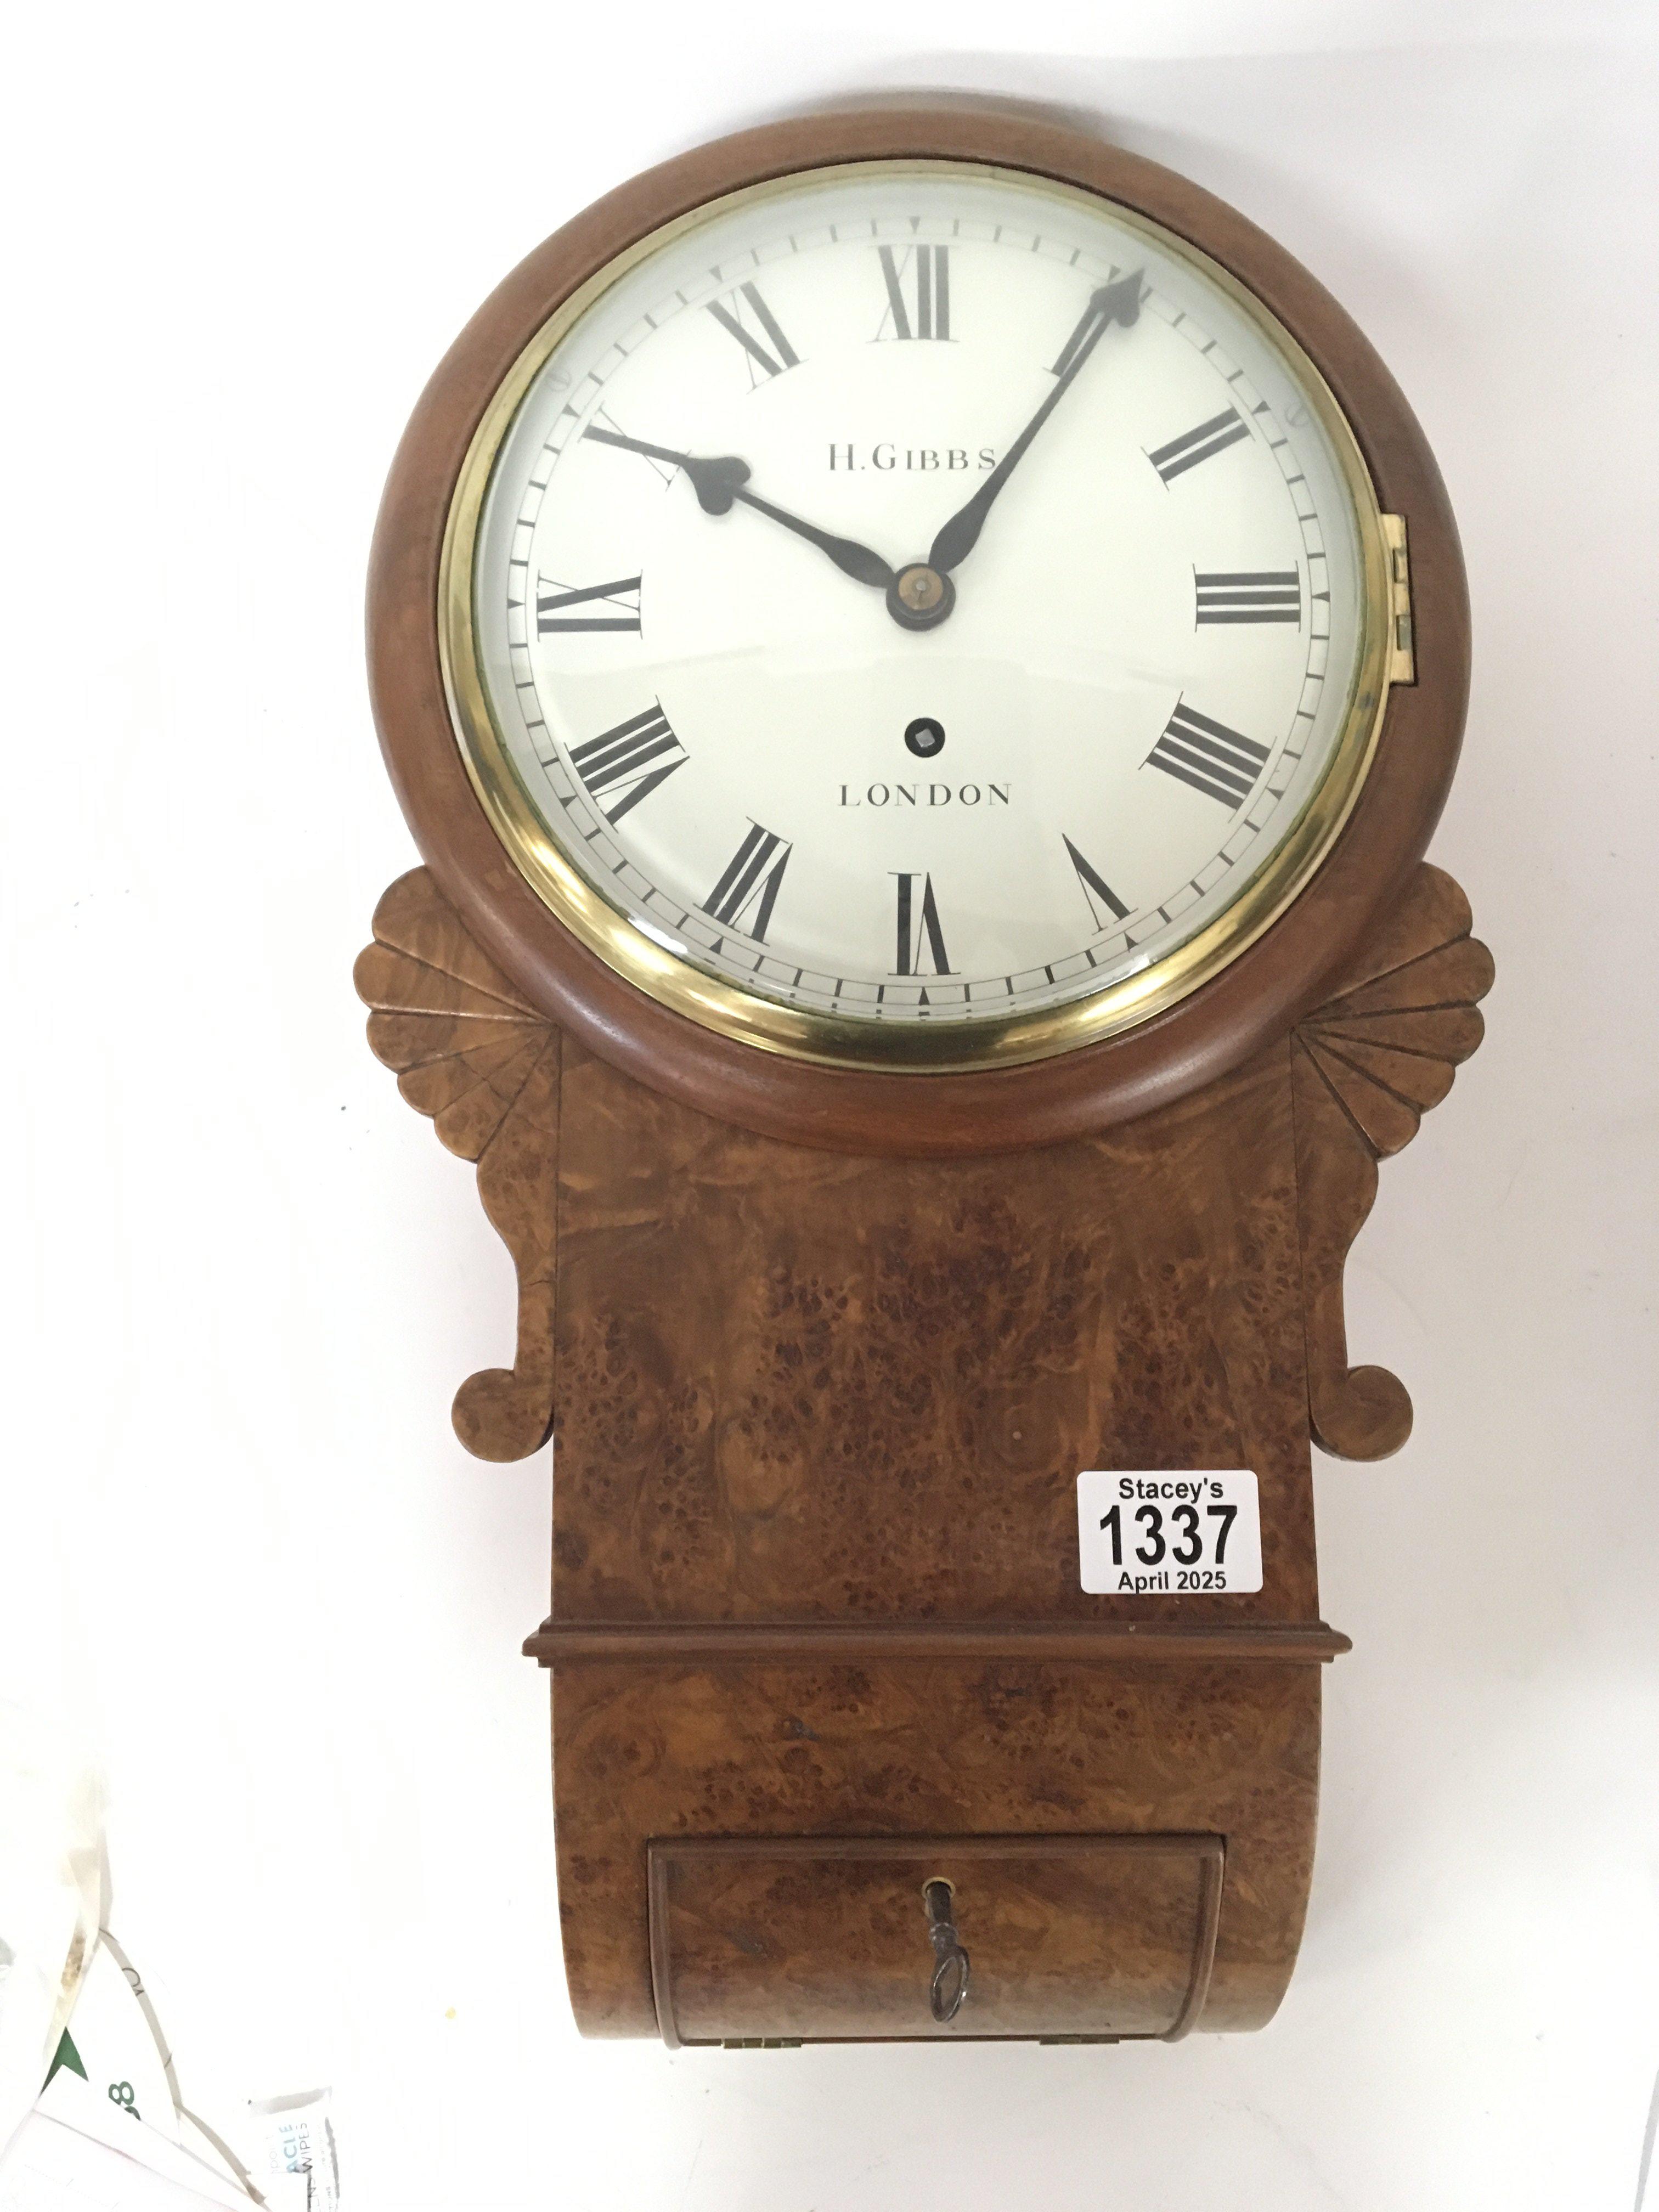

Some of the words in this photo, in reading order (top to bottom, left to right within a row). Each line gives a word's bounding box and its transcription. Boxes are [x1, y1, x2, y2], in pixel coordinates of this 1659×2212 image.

[705, 279, 810, 394] XI
[866, 243, 958, 343] XII
[1140, 401, 1256, 492] II
[537, 569, 643, 640] IX
[1193, 562, 1301, 634] III
[563, 695, 690, 833] VIII
[838, 783, 1011, 806] LONDON
[1138, 691, 1278, 825] IIII
[694, 816, 793, 947] VII
[887, 870, 960, 977] VI
[1062, 833, 1139, 935] V
[1100, 1504, 1237, 1566] 1337
[1119, 1477, 1223, 1504] Stacey's
[1118, 1571, 1169, 1594] April
[1177, 1571, 1226, 1589] 2025
